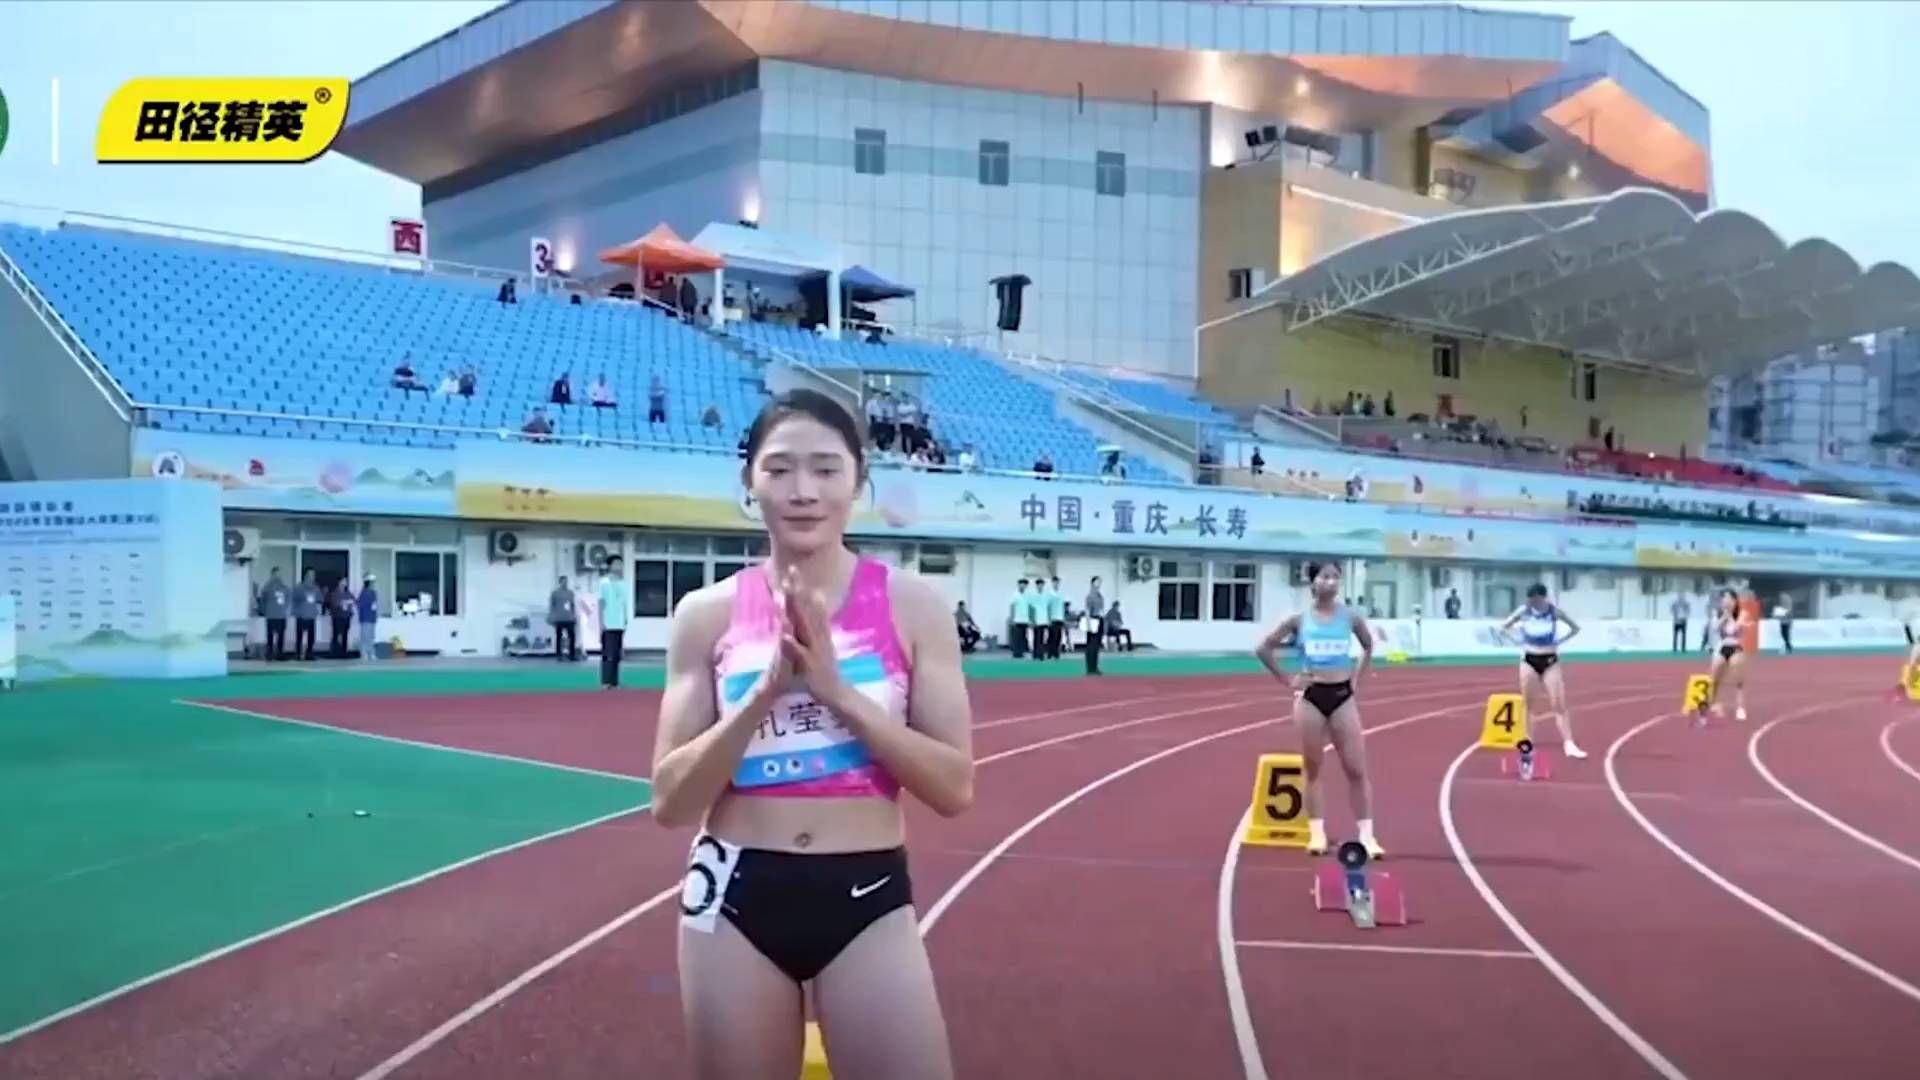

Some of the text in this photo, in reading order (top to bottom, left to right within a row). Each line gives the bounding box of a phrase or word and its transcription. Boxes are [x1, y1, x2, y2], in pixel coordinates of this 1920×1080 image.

[391, 220, 423, 255] 西
[1493, 701, 1515, 732] 4
[1265, 767, 1302, 820] 5
[680, 835, 726, 916] 6
